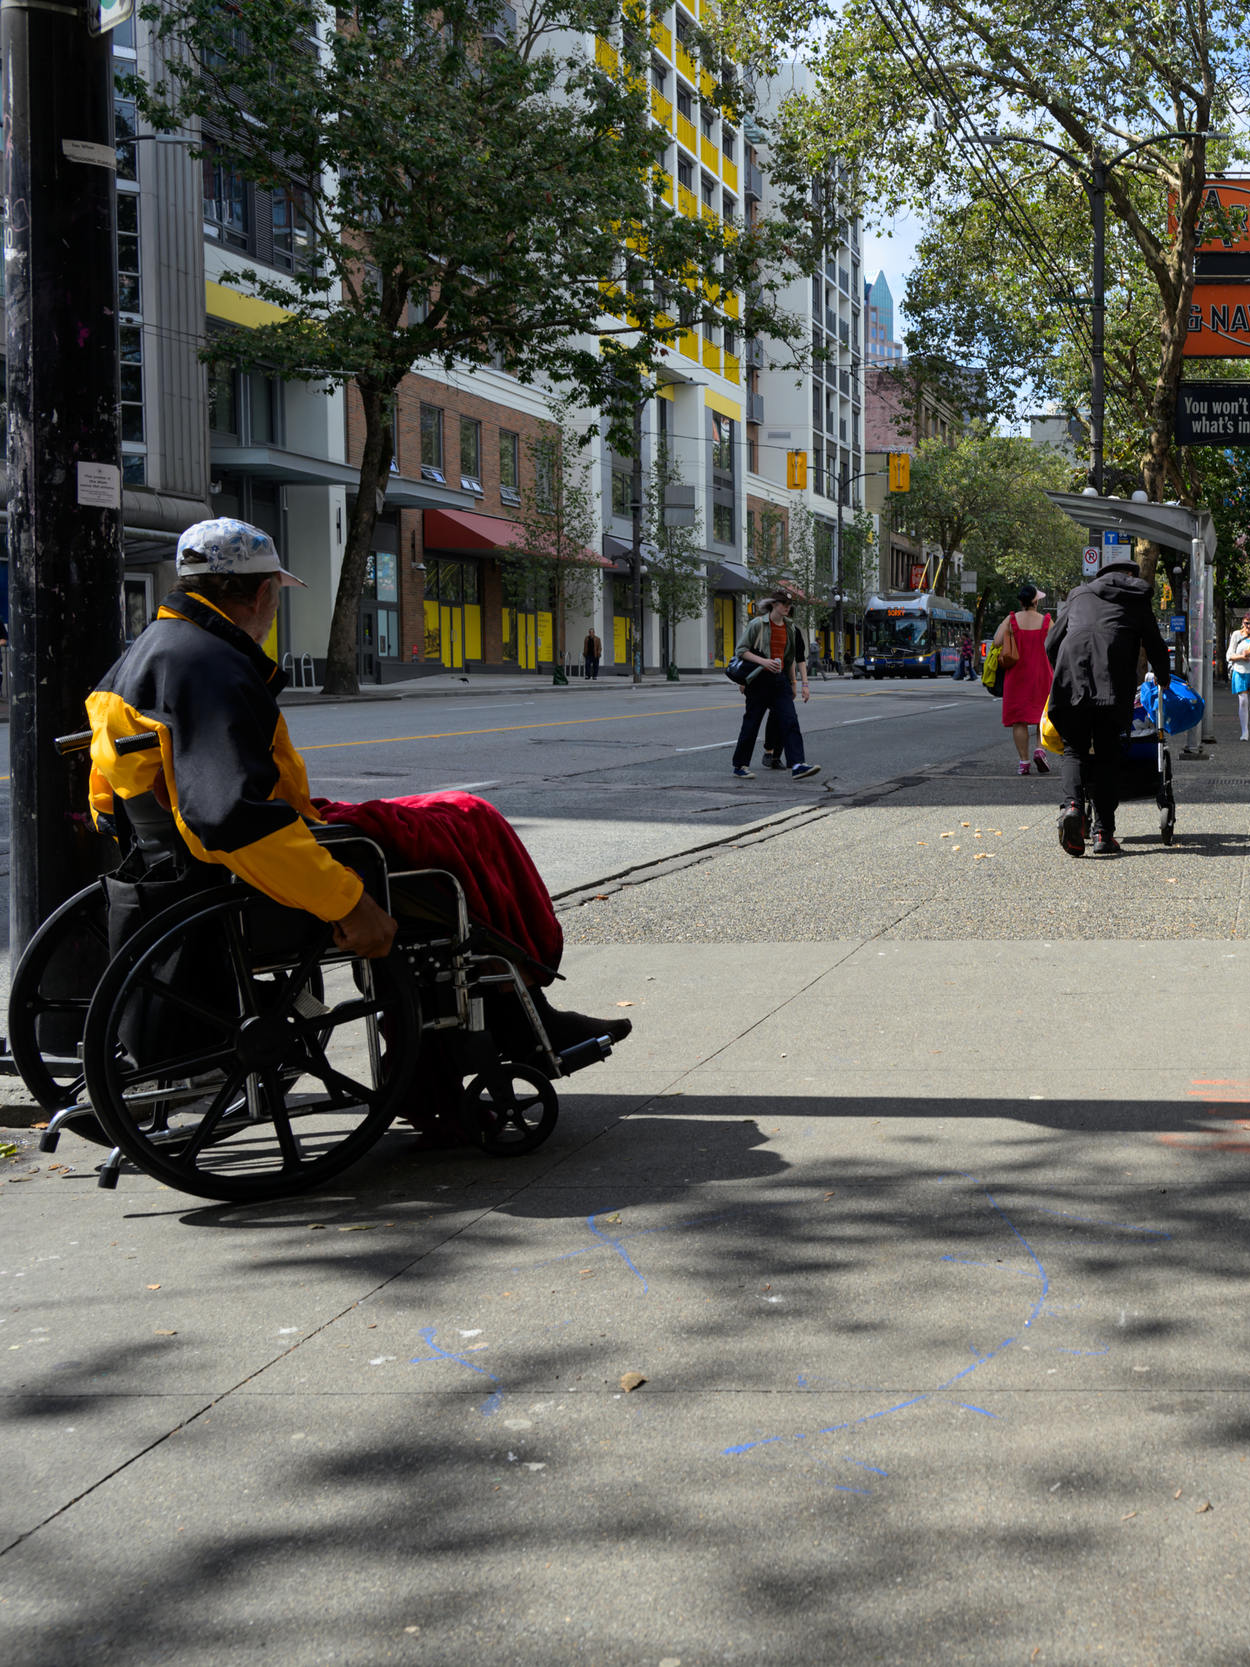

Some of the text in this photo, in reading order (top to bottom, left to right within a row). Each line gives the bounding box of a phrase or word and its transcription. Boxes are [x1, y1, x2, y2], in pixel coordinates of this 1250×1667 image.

[1184, 396, 1208, 415] You
[1238, 416, 1250, 434] in
[887, 609, 905, 617] SORRY
